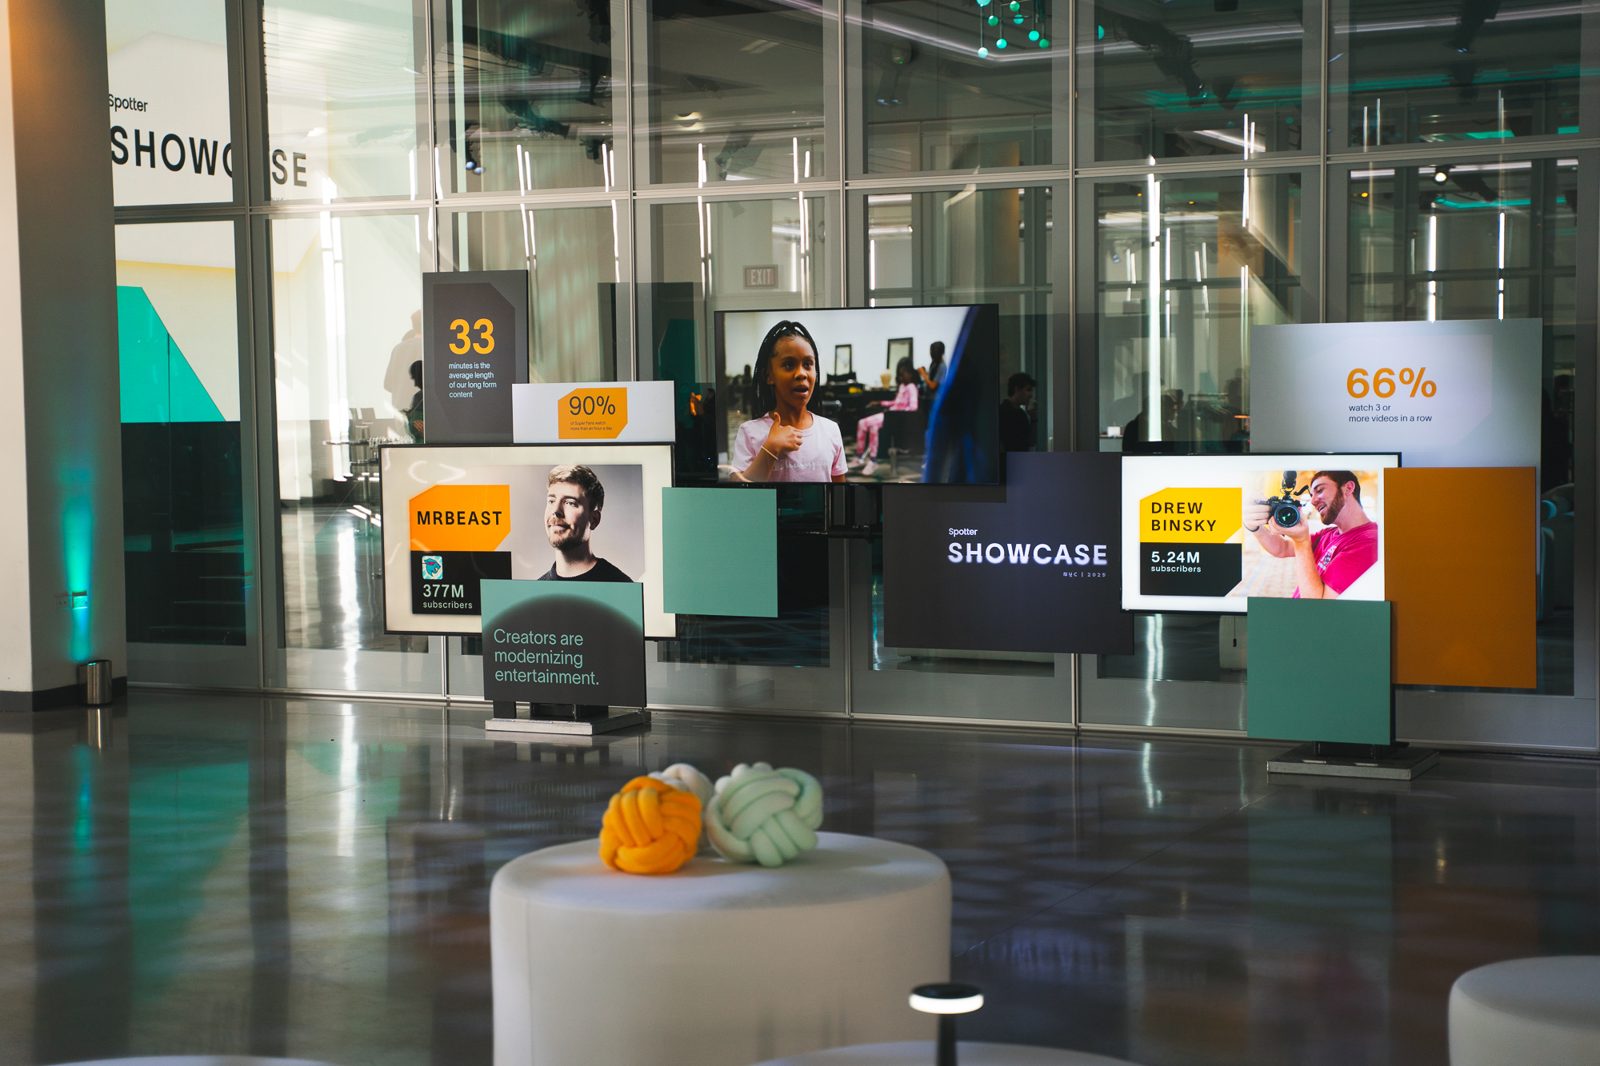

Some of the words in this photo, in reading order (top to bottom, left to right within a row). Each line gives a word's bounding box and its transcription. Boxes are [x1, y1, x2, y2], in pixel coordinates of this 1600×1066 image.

[108, 93, 148, 112] Spotter
[750, 268, 772, 286] EXIT
[448, 318, 495, 355] 33
[474, 371, 495, 380] length
[1346, 367, 1437, 398] 66%
[448, 381, 456, 389] of
[467, 381, 482, 390] long
[569, 395, 616, 415] 90%
[1371, 414, 1399, 422] videos
[1151, 502, 1203, 514] DREW
[417, 511, 502, 525] MRBEAST
[948, 528, 978, 537] Spotter
[1151, 519, 1217, 532] BINSKY
[947, 542, 1108, 566] SHOWCASE
[1151, 551, 1200, 563] 5.24M
[1150, 565, 1202, 573] subscribers
[422, 584, 464, 598] 377M
[422, 600, 473, 609] subscribers
[493, 628, 557, 645] Creators
[560, 633, 584, 646] are
[494, 649, 583, 669] modernizing
[494, 669, 600, 685] entertainment.
